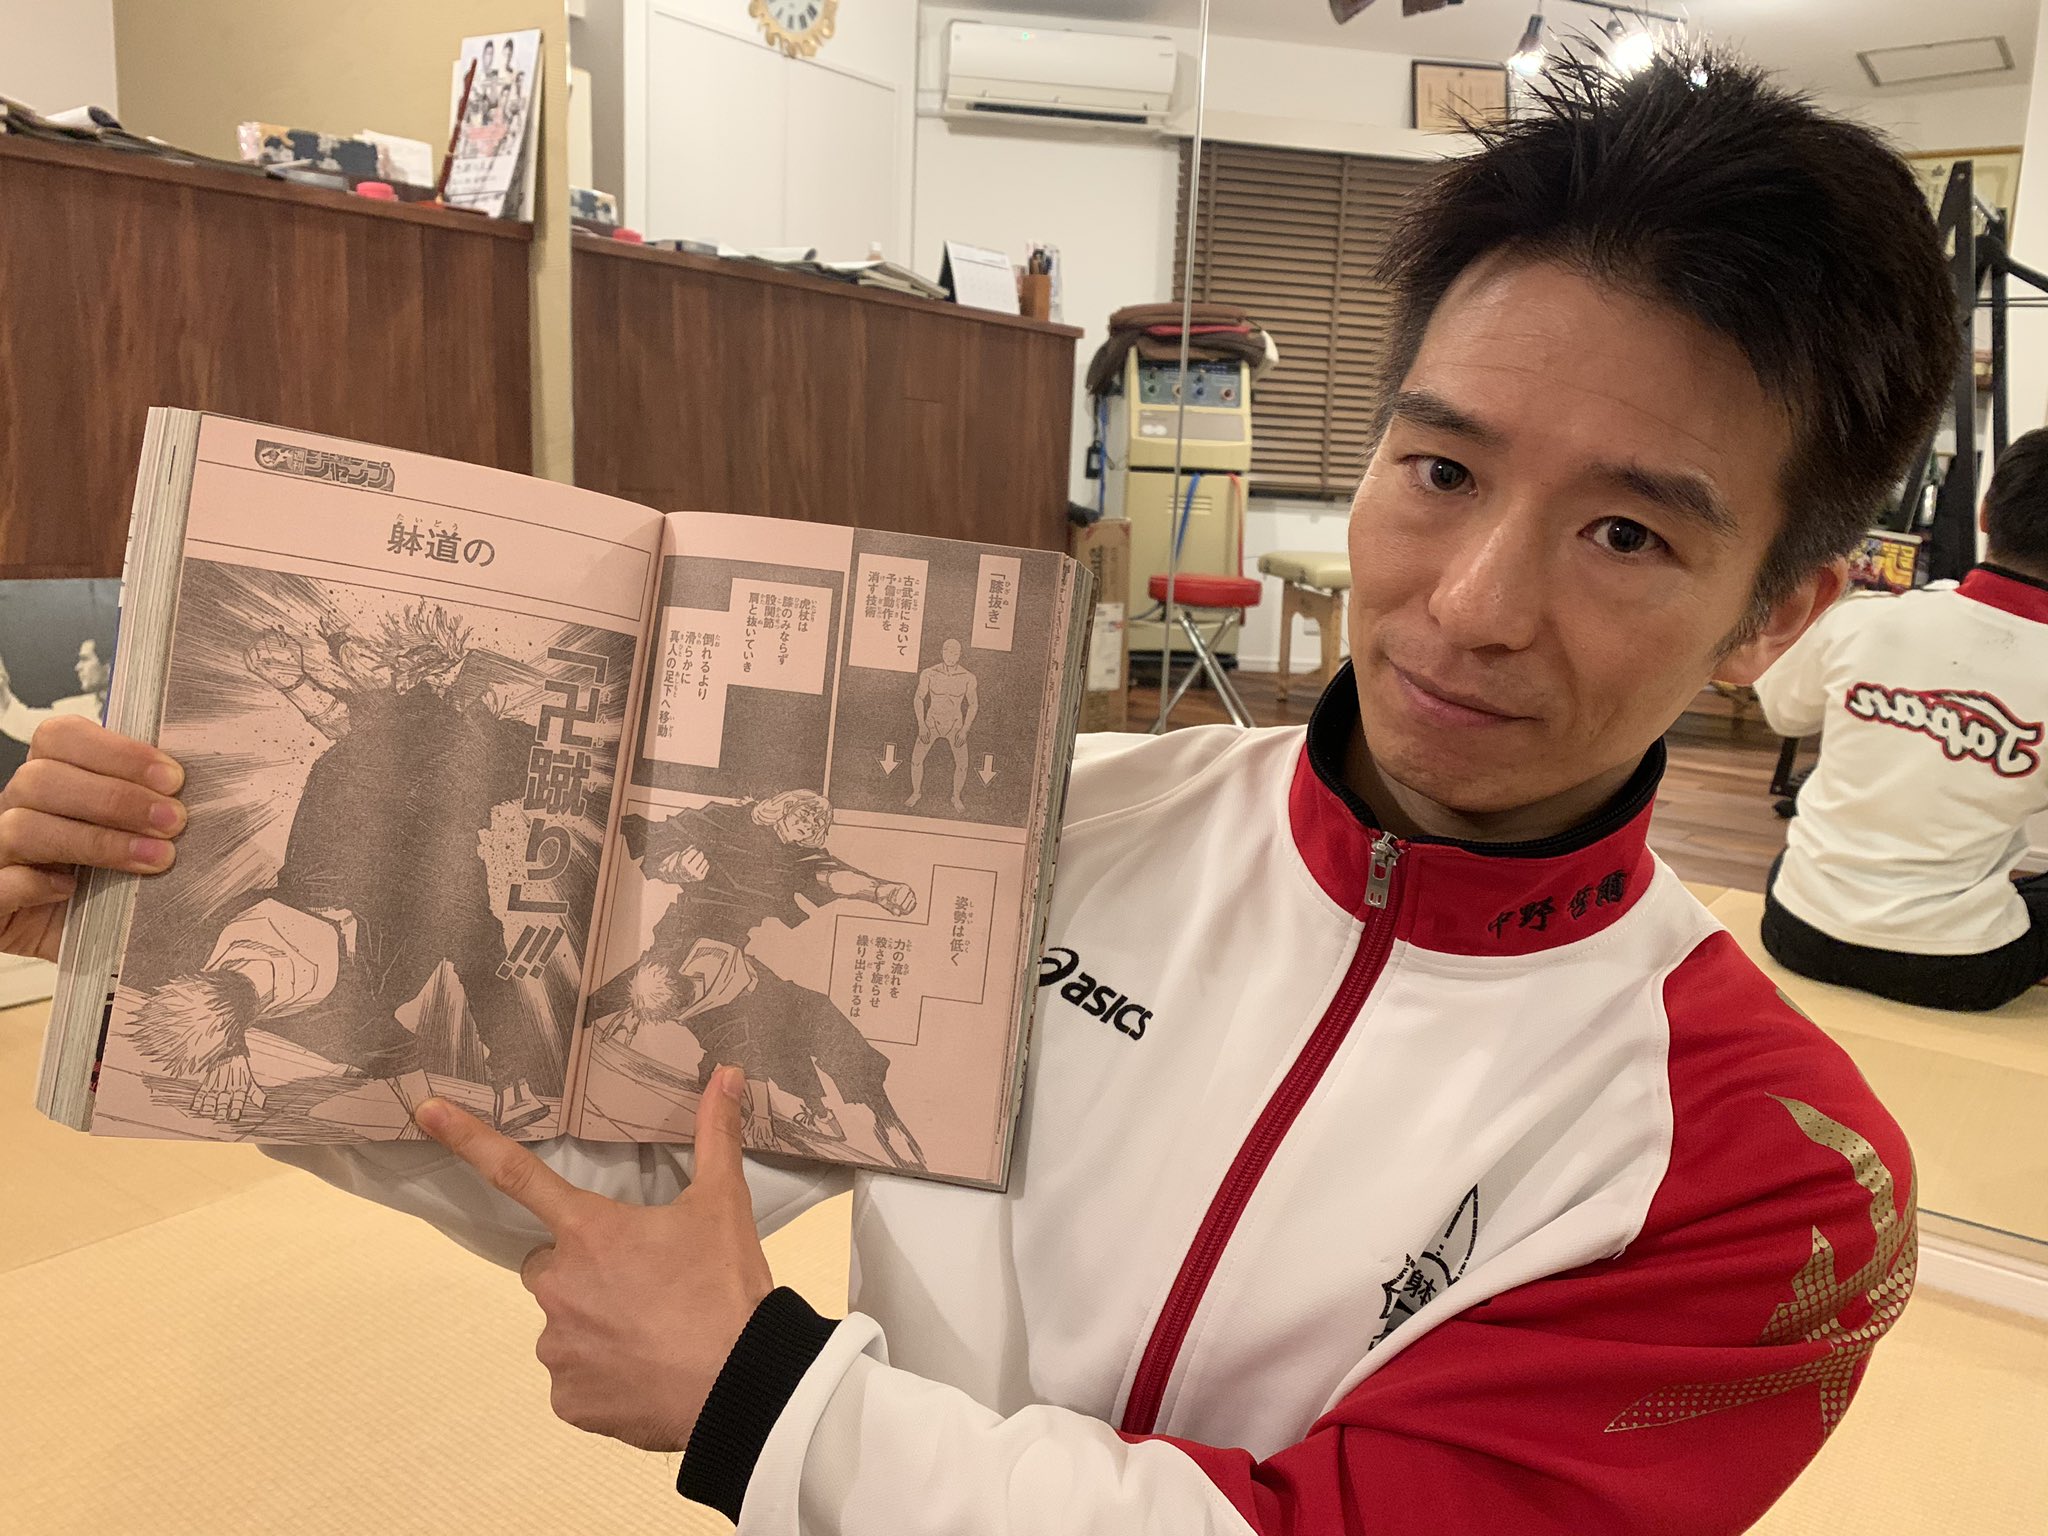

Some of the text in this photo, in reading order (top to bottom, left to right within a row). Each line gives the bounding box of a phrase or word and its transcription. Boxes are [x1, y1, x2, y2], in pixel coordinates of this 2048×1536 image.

[386, 521, 496, 567] 躰道の
[763, 594, 777, 629] 股関節
[798, 598, 811, 632] 虎杖は
[865, 571, 880, 618] 消す技術
[882, 573, 897, 631] 予備動作を
[897, 575, 915, 656] 古武術において
[985, 572, 1006, 630] 「膝抜き」
[681, 631, 696, 684] 滑らかに
[743, 592, 760, 673] 肩と抜いていき
[778, 596, 794, 665] 膝のみならず
[657, 630, 680, 738] 真人の足下へ移動
[698, 633, 715, 700] 倒れるより
[950, 896, 969, 966] 姿勢は低く
[850, 934, 869, 1017] 繰り出されるは
[869, 936, 887, 1008] 殺さず旋らせ
[889, 938, 906, 999] 力の流れを
[1060, 971, 1154, 1041] asics
